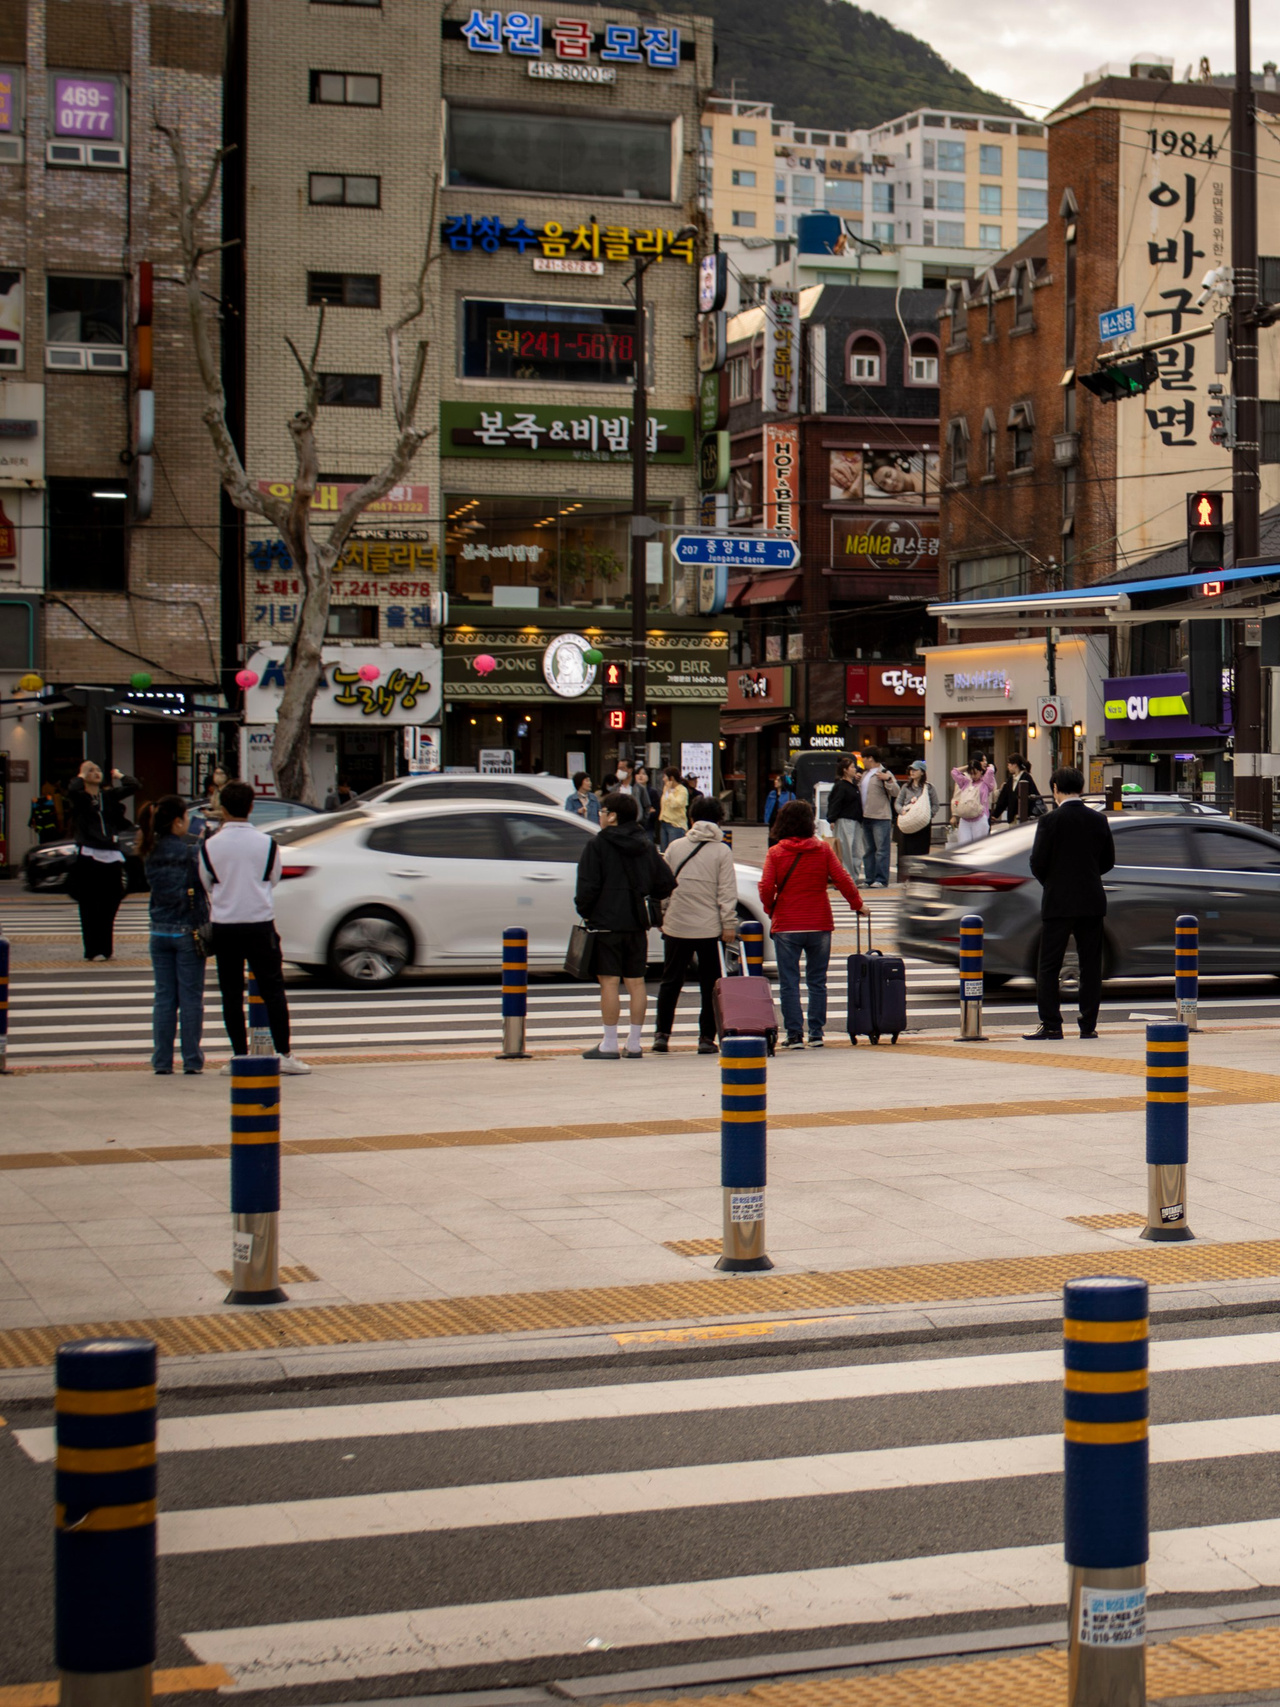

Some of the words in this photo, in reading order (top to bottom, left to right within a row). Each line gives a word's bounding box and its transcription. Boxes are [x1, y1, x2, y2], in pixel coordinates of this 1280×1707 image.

[461, 10, 502, 55] 선원
[552, 18, 595, 61] 급
[601, 25, 681, 68] 모집
[62, 86, 110, 108] 469-
[61, 109, 110, 131] 0777
[1147, 128, 1218, 160] 1984
[521, 331, 634, 361] 241-5678
[774, 443, 791, 478] HOF
[681, 544, 698, 555] 207
[705, 539, 767, 554] 중앙대로
[777, 548, 790, 559] 211
[707, 553, 765, 564] Jungang-daero
[679, 660, 711, 673] BAR
[333, 668, 431, 715] 노래방
[1045, 709, 1055, 719] 30
[1127, 695, 1148, 721] CU
[610, 711, 624, 729] 13
[816, 724, 839, 735] HOF
[250, 733, 272, 744] KTX
[810, 736, 845, 747] CHICKEN
